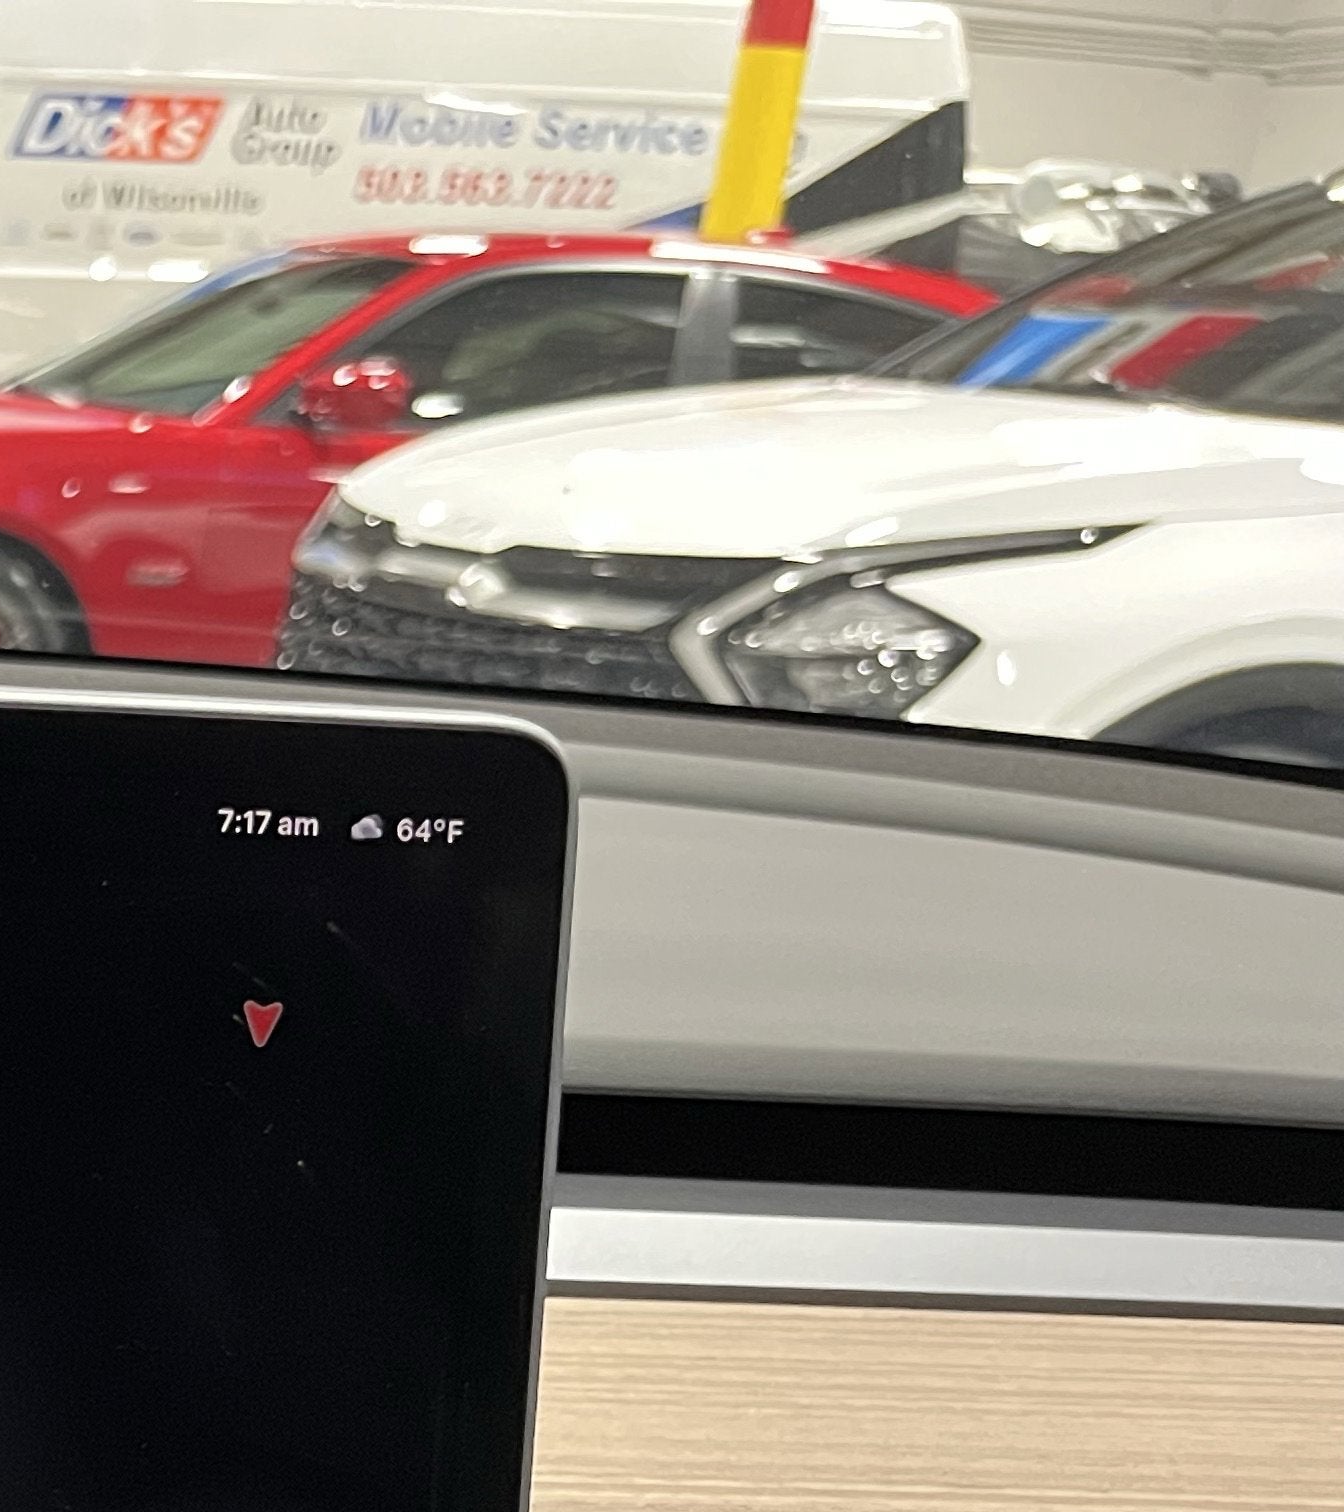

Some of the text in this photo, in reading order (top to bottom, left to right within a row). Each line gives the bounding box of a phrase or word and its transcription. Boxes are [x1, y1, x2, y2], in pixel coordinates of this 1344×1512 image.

[360, 100, 710, 155] Mobile Service
[217, 807, 319, 837] 7:17 am
[396, 817, 465, 844] 64°F
